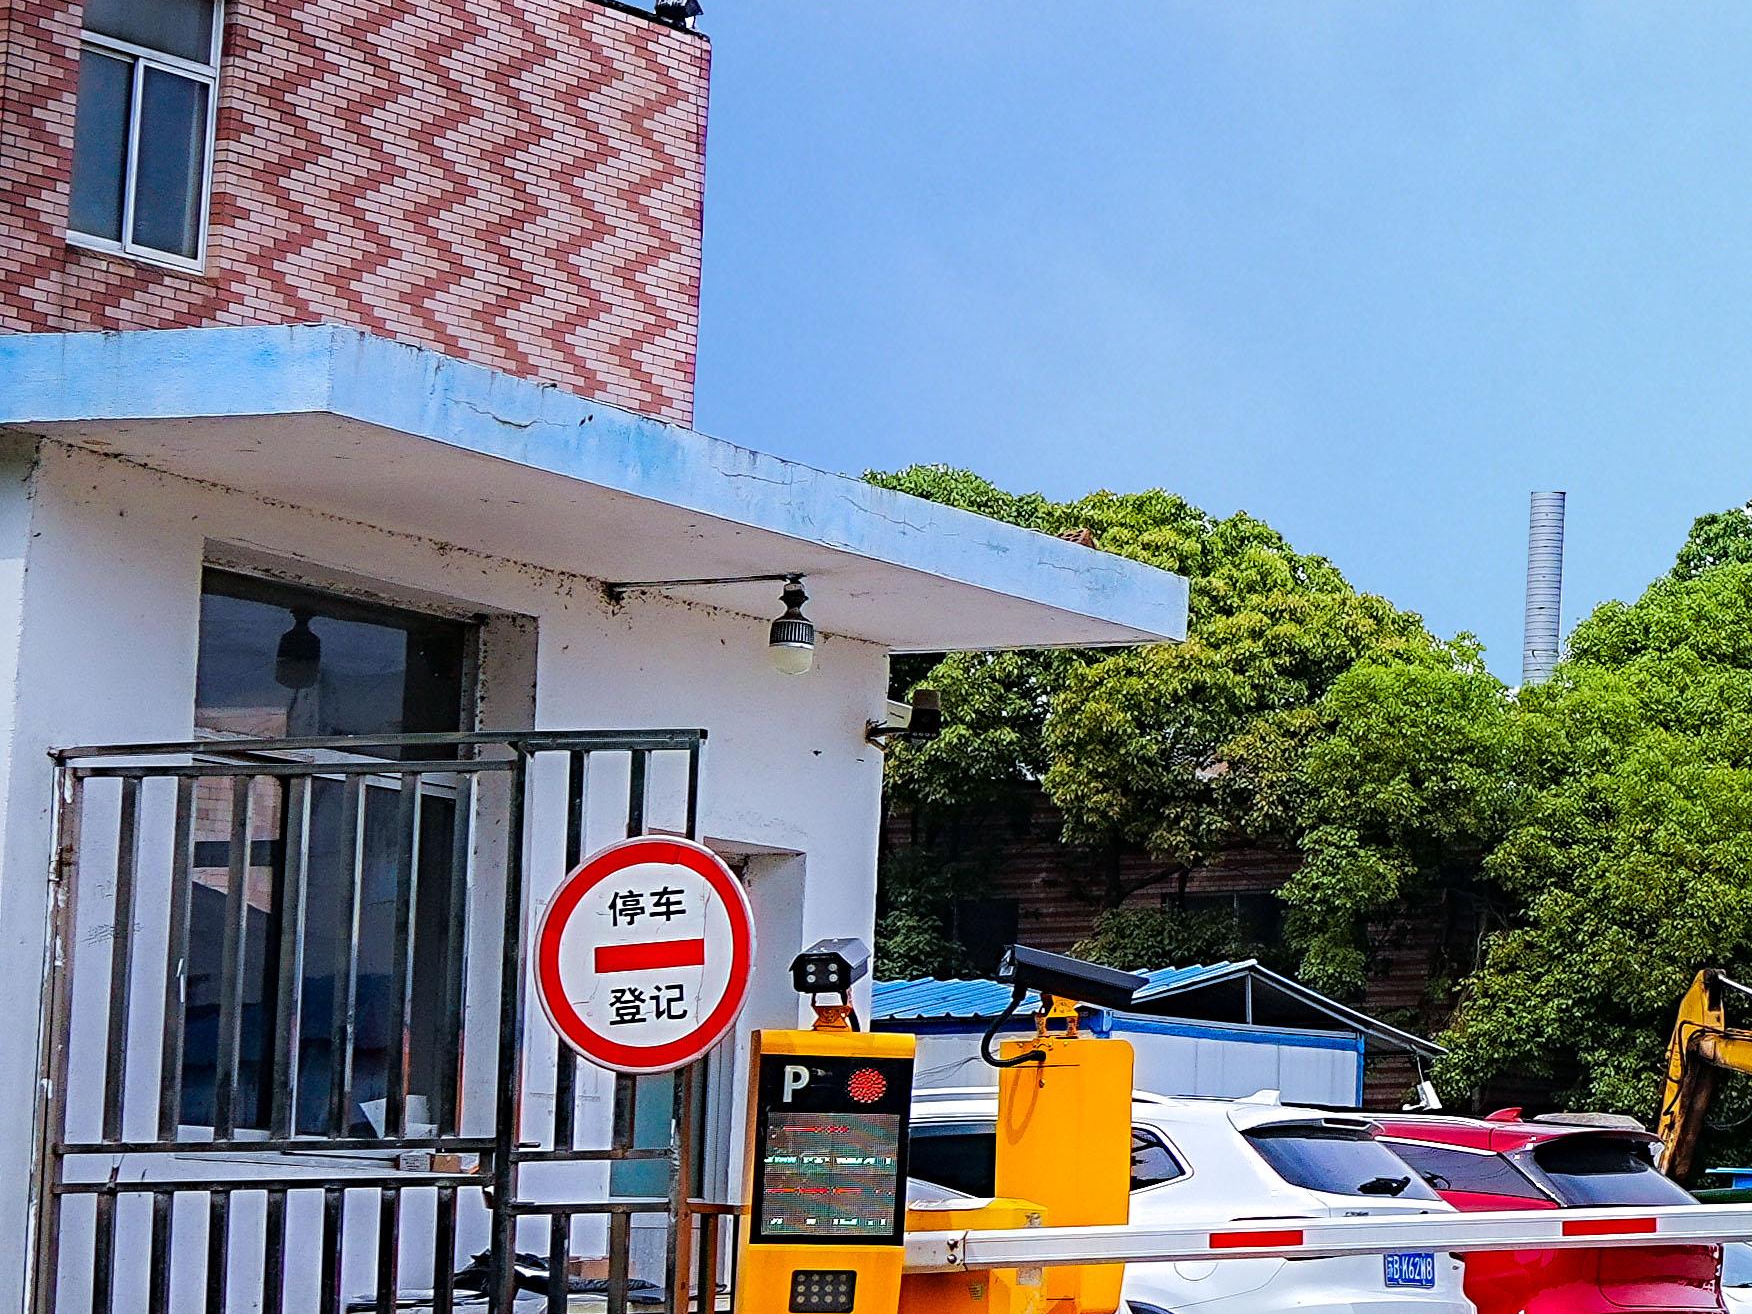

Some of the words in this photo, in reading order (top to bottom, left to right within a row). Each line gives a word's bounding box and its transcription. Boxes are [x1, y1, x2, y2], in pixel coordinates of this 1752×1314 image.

[608, 886, 686, 926] 停车
[609, 984, 687, 1026] 登记
[782, 1065, 810, 1103] P
